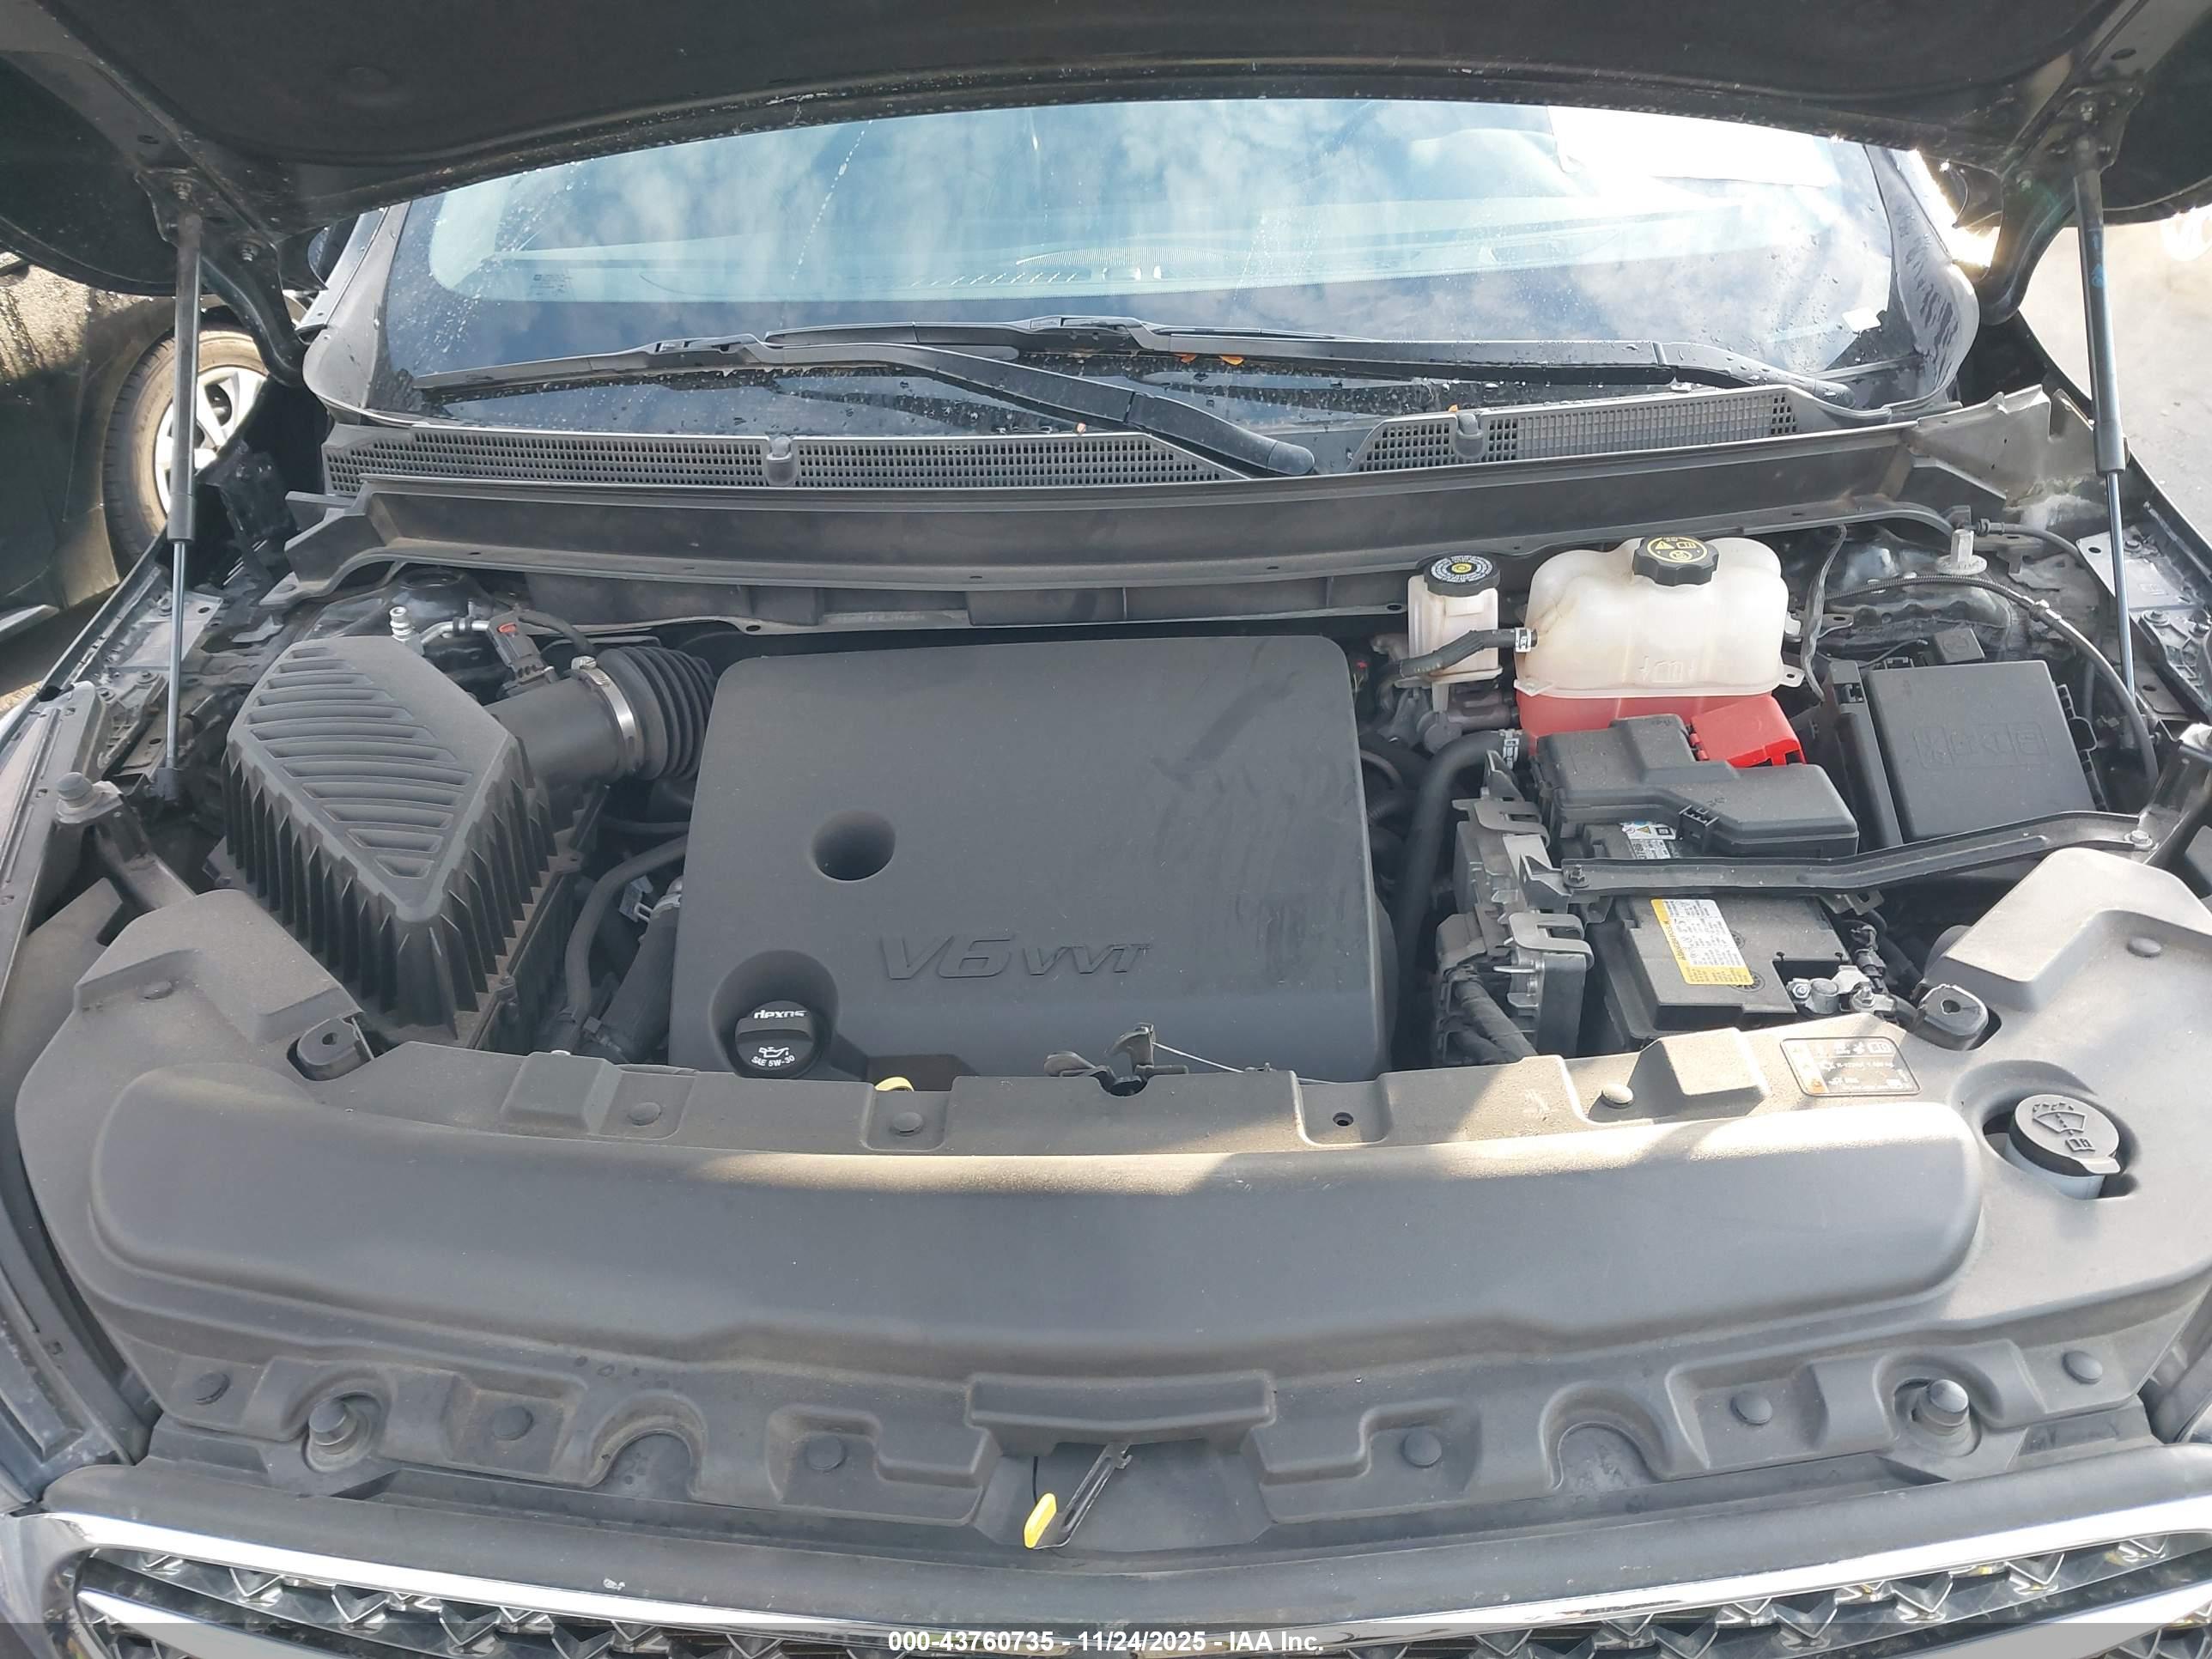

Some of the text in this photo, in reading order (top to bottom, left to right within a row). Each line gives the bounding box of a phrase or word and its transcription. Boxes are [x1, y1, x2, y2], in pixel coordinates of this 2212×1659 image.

[878, 934, 1152, 981] V6 VVT
[751, 1054, 795, 1067] SAE 5W-30
